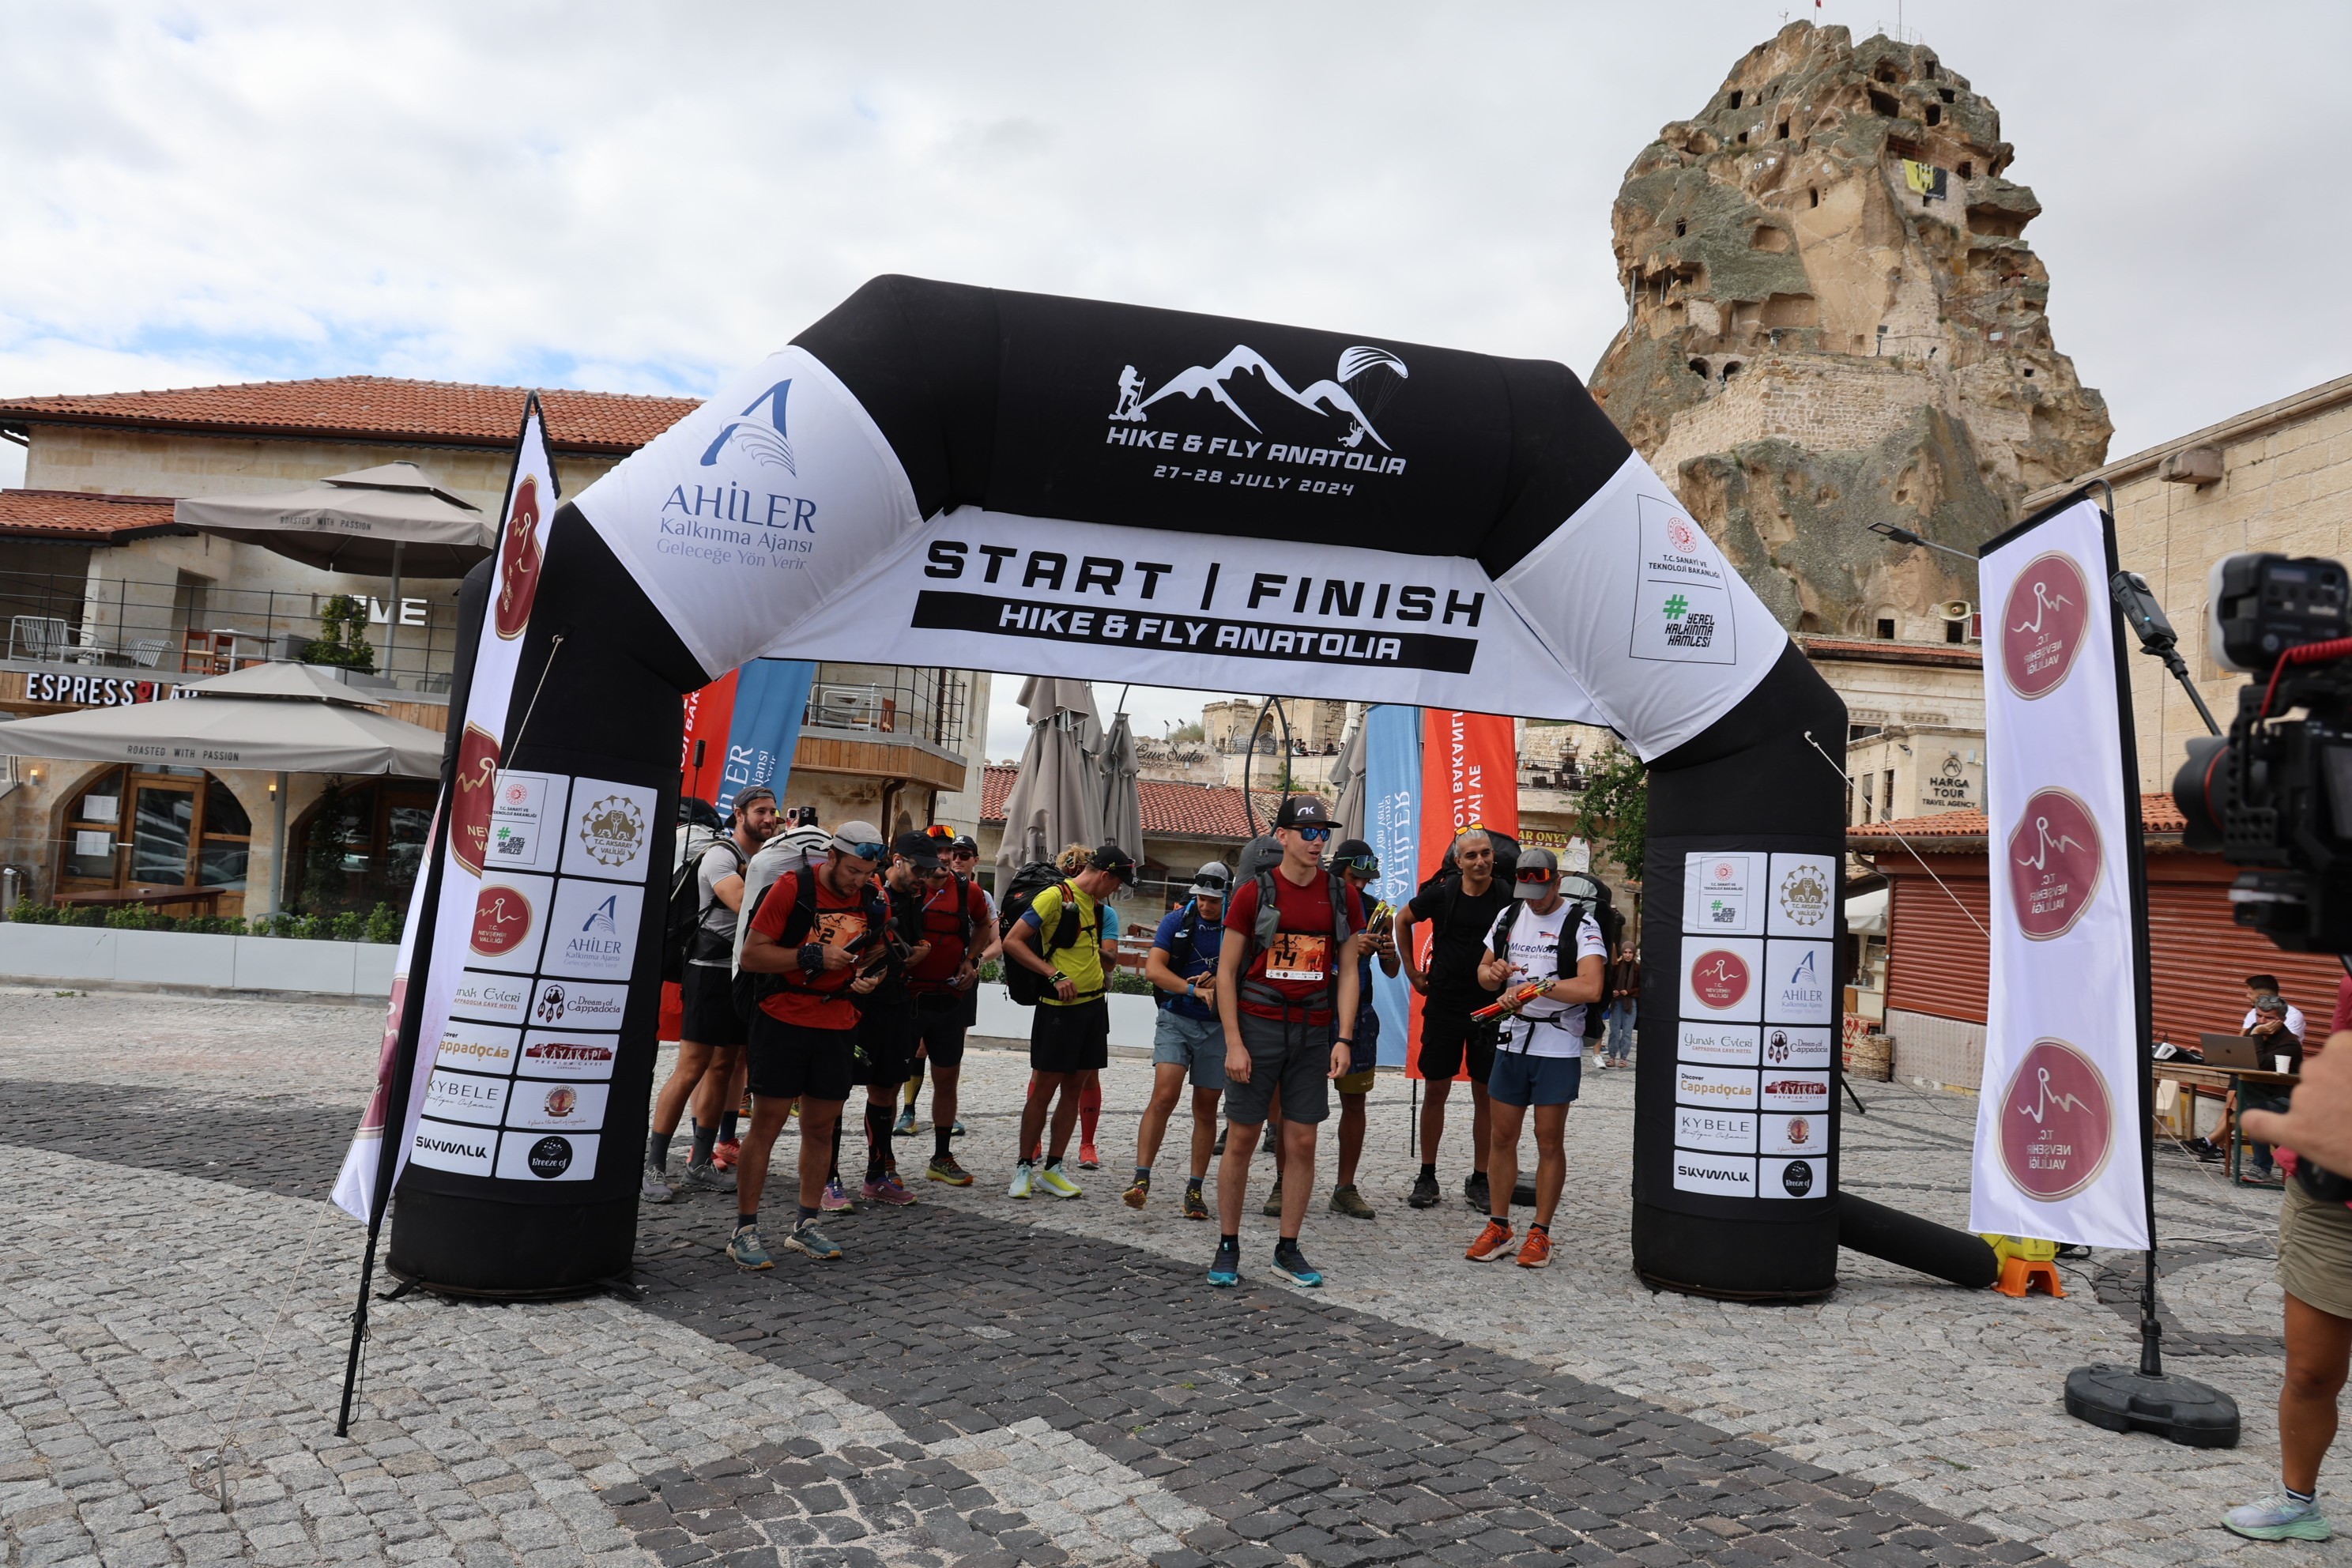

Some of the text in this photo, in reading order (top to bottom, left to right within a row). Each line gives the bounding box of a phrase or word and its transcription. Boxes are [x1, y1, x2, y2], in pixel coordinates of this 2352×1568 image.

[1106, 426, 1407, 475] HIKE & FLY ANATOLIA
[1153, 465, 1355, 496] 27-28 JULY 2024
[661, 481, 816, 533] AHİLER
[279, 516, 371, 531] ROASTED WITH PASSION
[660, 517, 813, 553] Kalkınma Ajansı
[657, 538, 807, 570] Geleceğe Yön Verir
[1676, 556, 1699, 566] SANAYİ
[1648, 562, 1721, 579] TEKNOLOJİ BAKANLIĞI
[923, 539, 1174, 600] START
[1247, 572, 1486, 628] FINISH
[999, 603, 1402, 661] HIKE & FLY ANATOLIA
[1664, 623, 1713, 636] KALKINMA
[1667, 635, 1711, 647] HAMLESİ
[126, 744, 239, 761] ROASTED WITH PASSION
[1167, 743, 1205, 763] Suites
[1930, 777, 1969, 788] HARGA
[1934, 788, 1964, 798] TOUR
[601, 847, 625, 856] VALİLİĞİ
[606, 840, 632, 849] AKSARAY
[819, 928, 835, 944] 2
[567, 937, 621, 954] AHİLER
[565, 951, 620, 962] Kalkınma Ajansı
[1274, 950, 1297, 967] 14
[454, 997, 482, 1006] APPADOCIA
[484, 988, 521, 1002] Evleri
[578, 996, 613, 1007] Dream of
[1781, 988, 1822, 1001] AHİLER
[567, 1000, 620, 1014] Cappadocia
[1684, 1033, 1752, 1047] Yunak Evleri
[439, 1040, 510, 1059] appadocia
[1790, 1043, 1828, 1054] Cappadocia
[1680, 1080, 1752, 1096] Cappadocia
[1682, 1117, 1750, 1132] KYBELE
[416, 1136, 487, 1159] SKYWALK
[532, 1157, 567, 1169] Breeze of
[1678, 1165, 1751, 1182] SKYWALK
